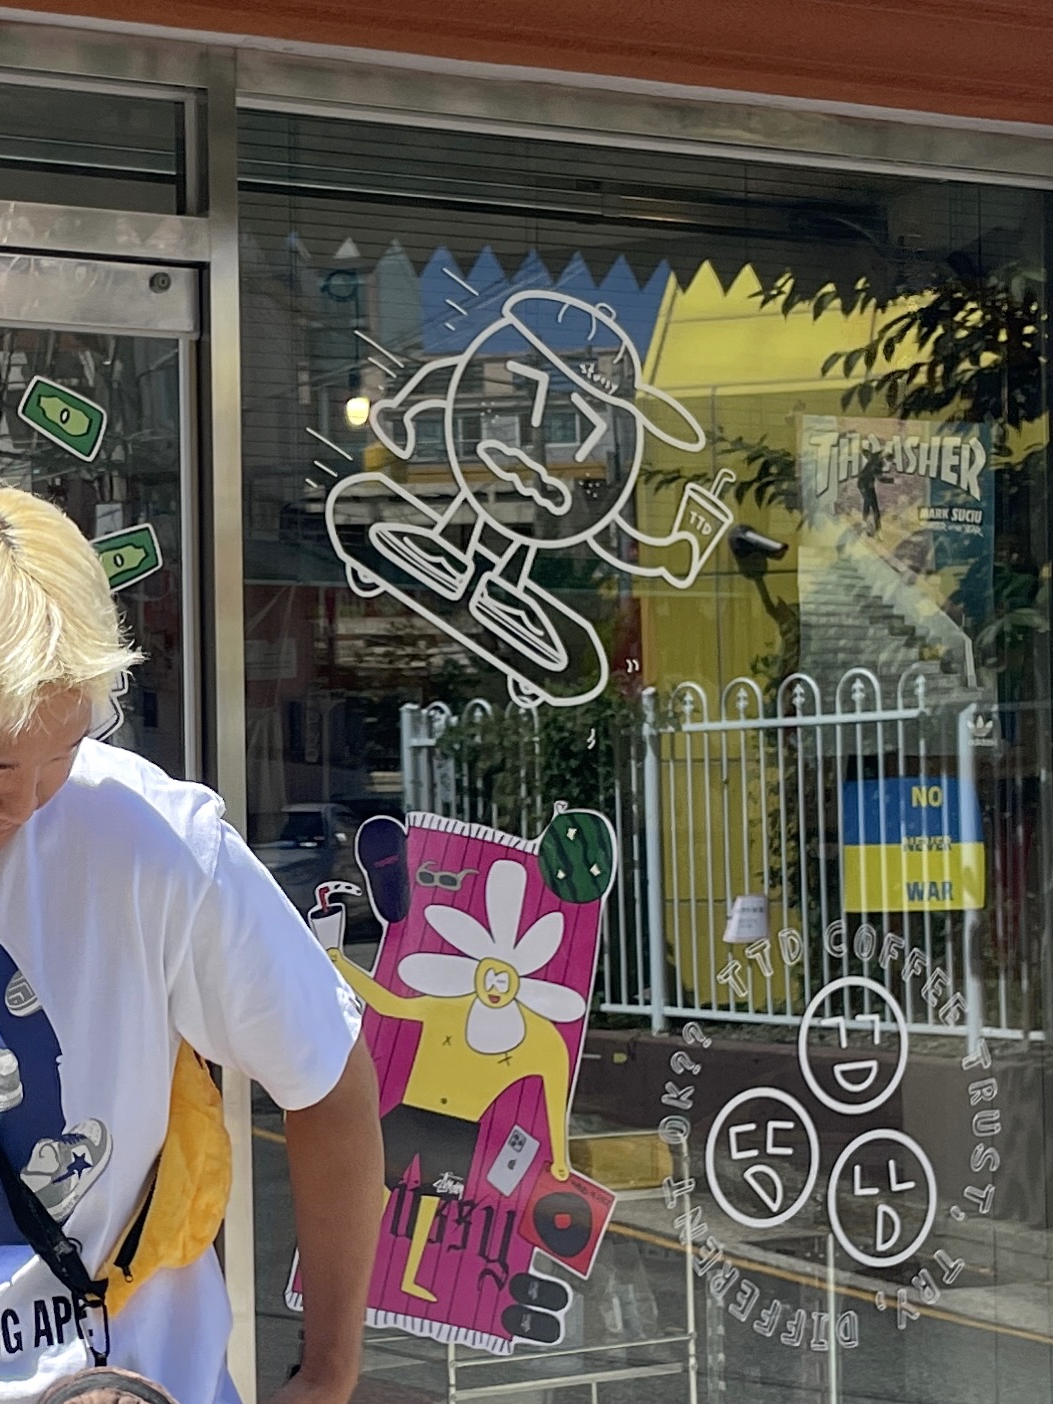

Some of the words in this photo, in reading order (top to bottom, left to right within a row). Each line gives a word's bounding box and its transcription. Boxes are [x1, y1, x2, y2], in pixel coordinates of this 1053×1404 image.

[809, 432, 987, 502] THRASHER
[690, 511, 712, 535] TTD
[920, 507, 949, 521] MARK
[951, 508, 983, 525] SUCIU
[911, 786, 944, 808] NO
[903, 836, 952, 852] NEVER
[906, 881, 953, 901] WAR
[717, 928, 803, 998] TTD
[823, 919, 969, 1028] COFFEE
